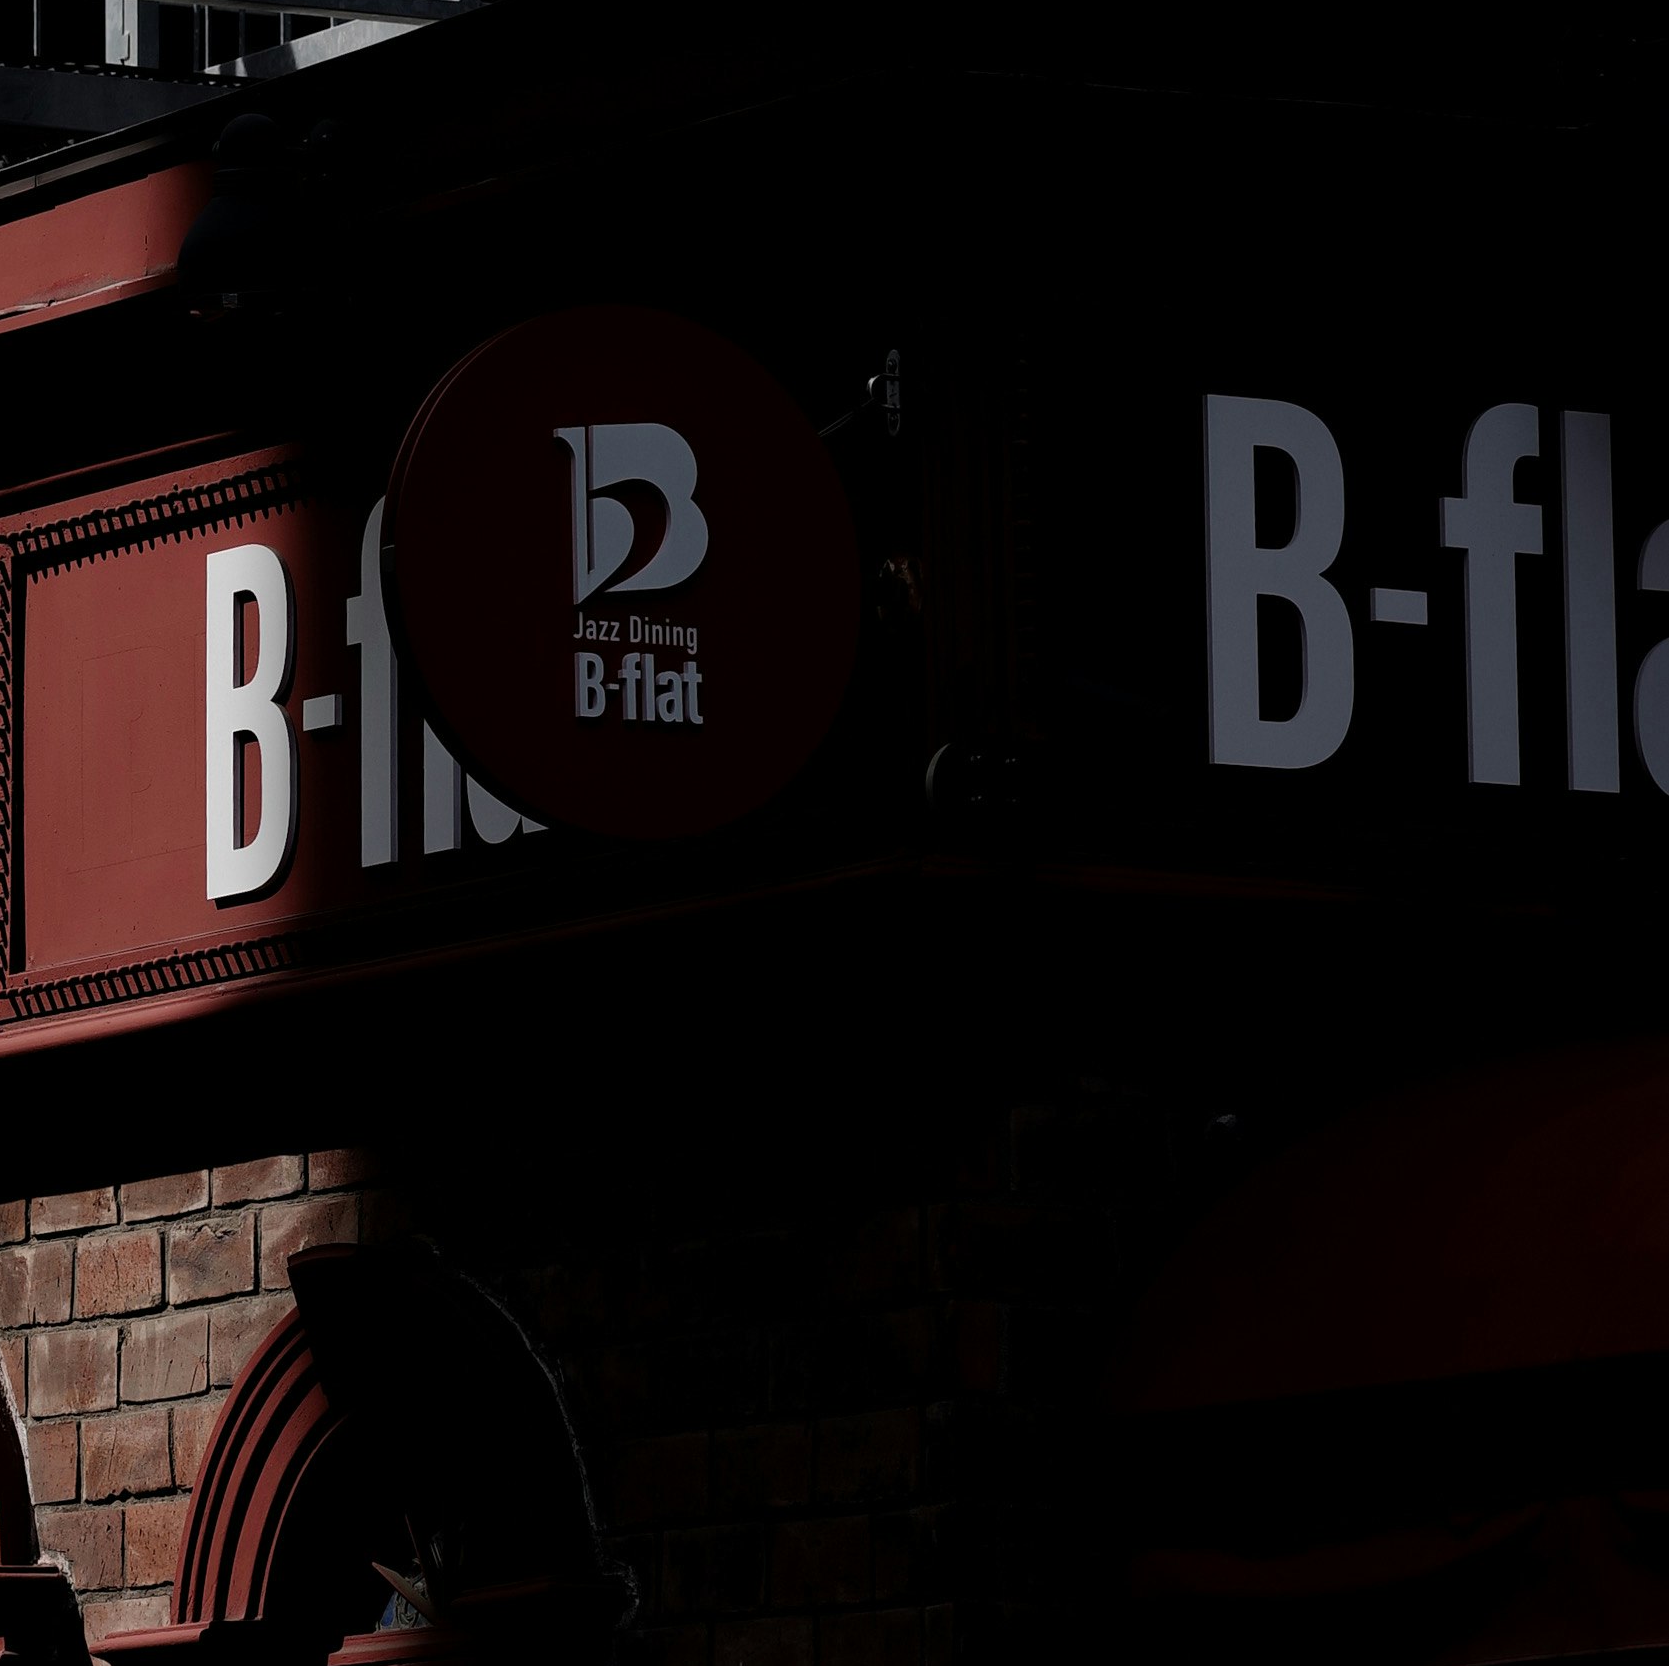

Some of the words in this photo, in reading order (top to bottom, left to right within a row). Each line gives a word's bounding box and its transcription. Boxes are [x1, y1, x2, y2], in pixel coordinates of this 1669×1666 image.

[206, 494, 551, 901] B-f
[573, 611, 621, 643] Jazz
[629, 615, 698, 655] Dining
[574, 652, 704, 724] B-flat
[1202, 393, 1669, 796] B-fl
